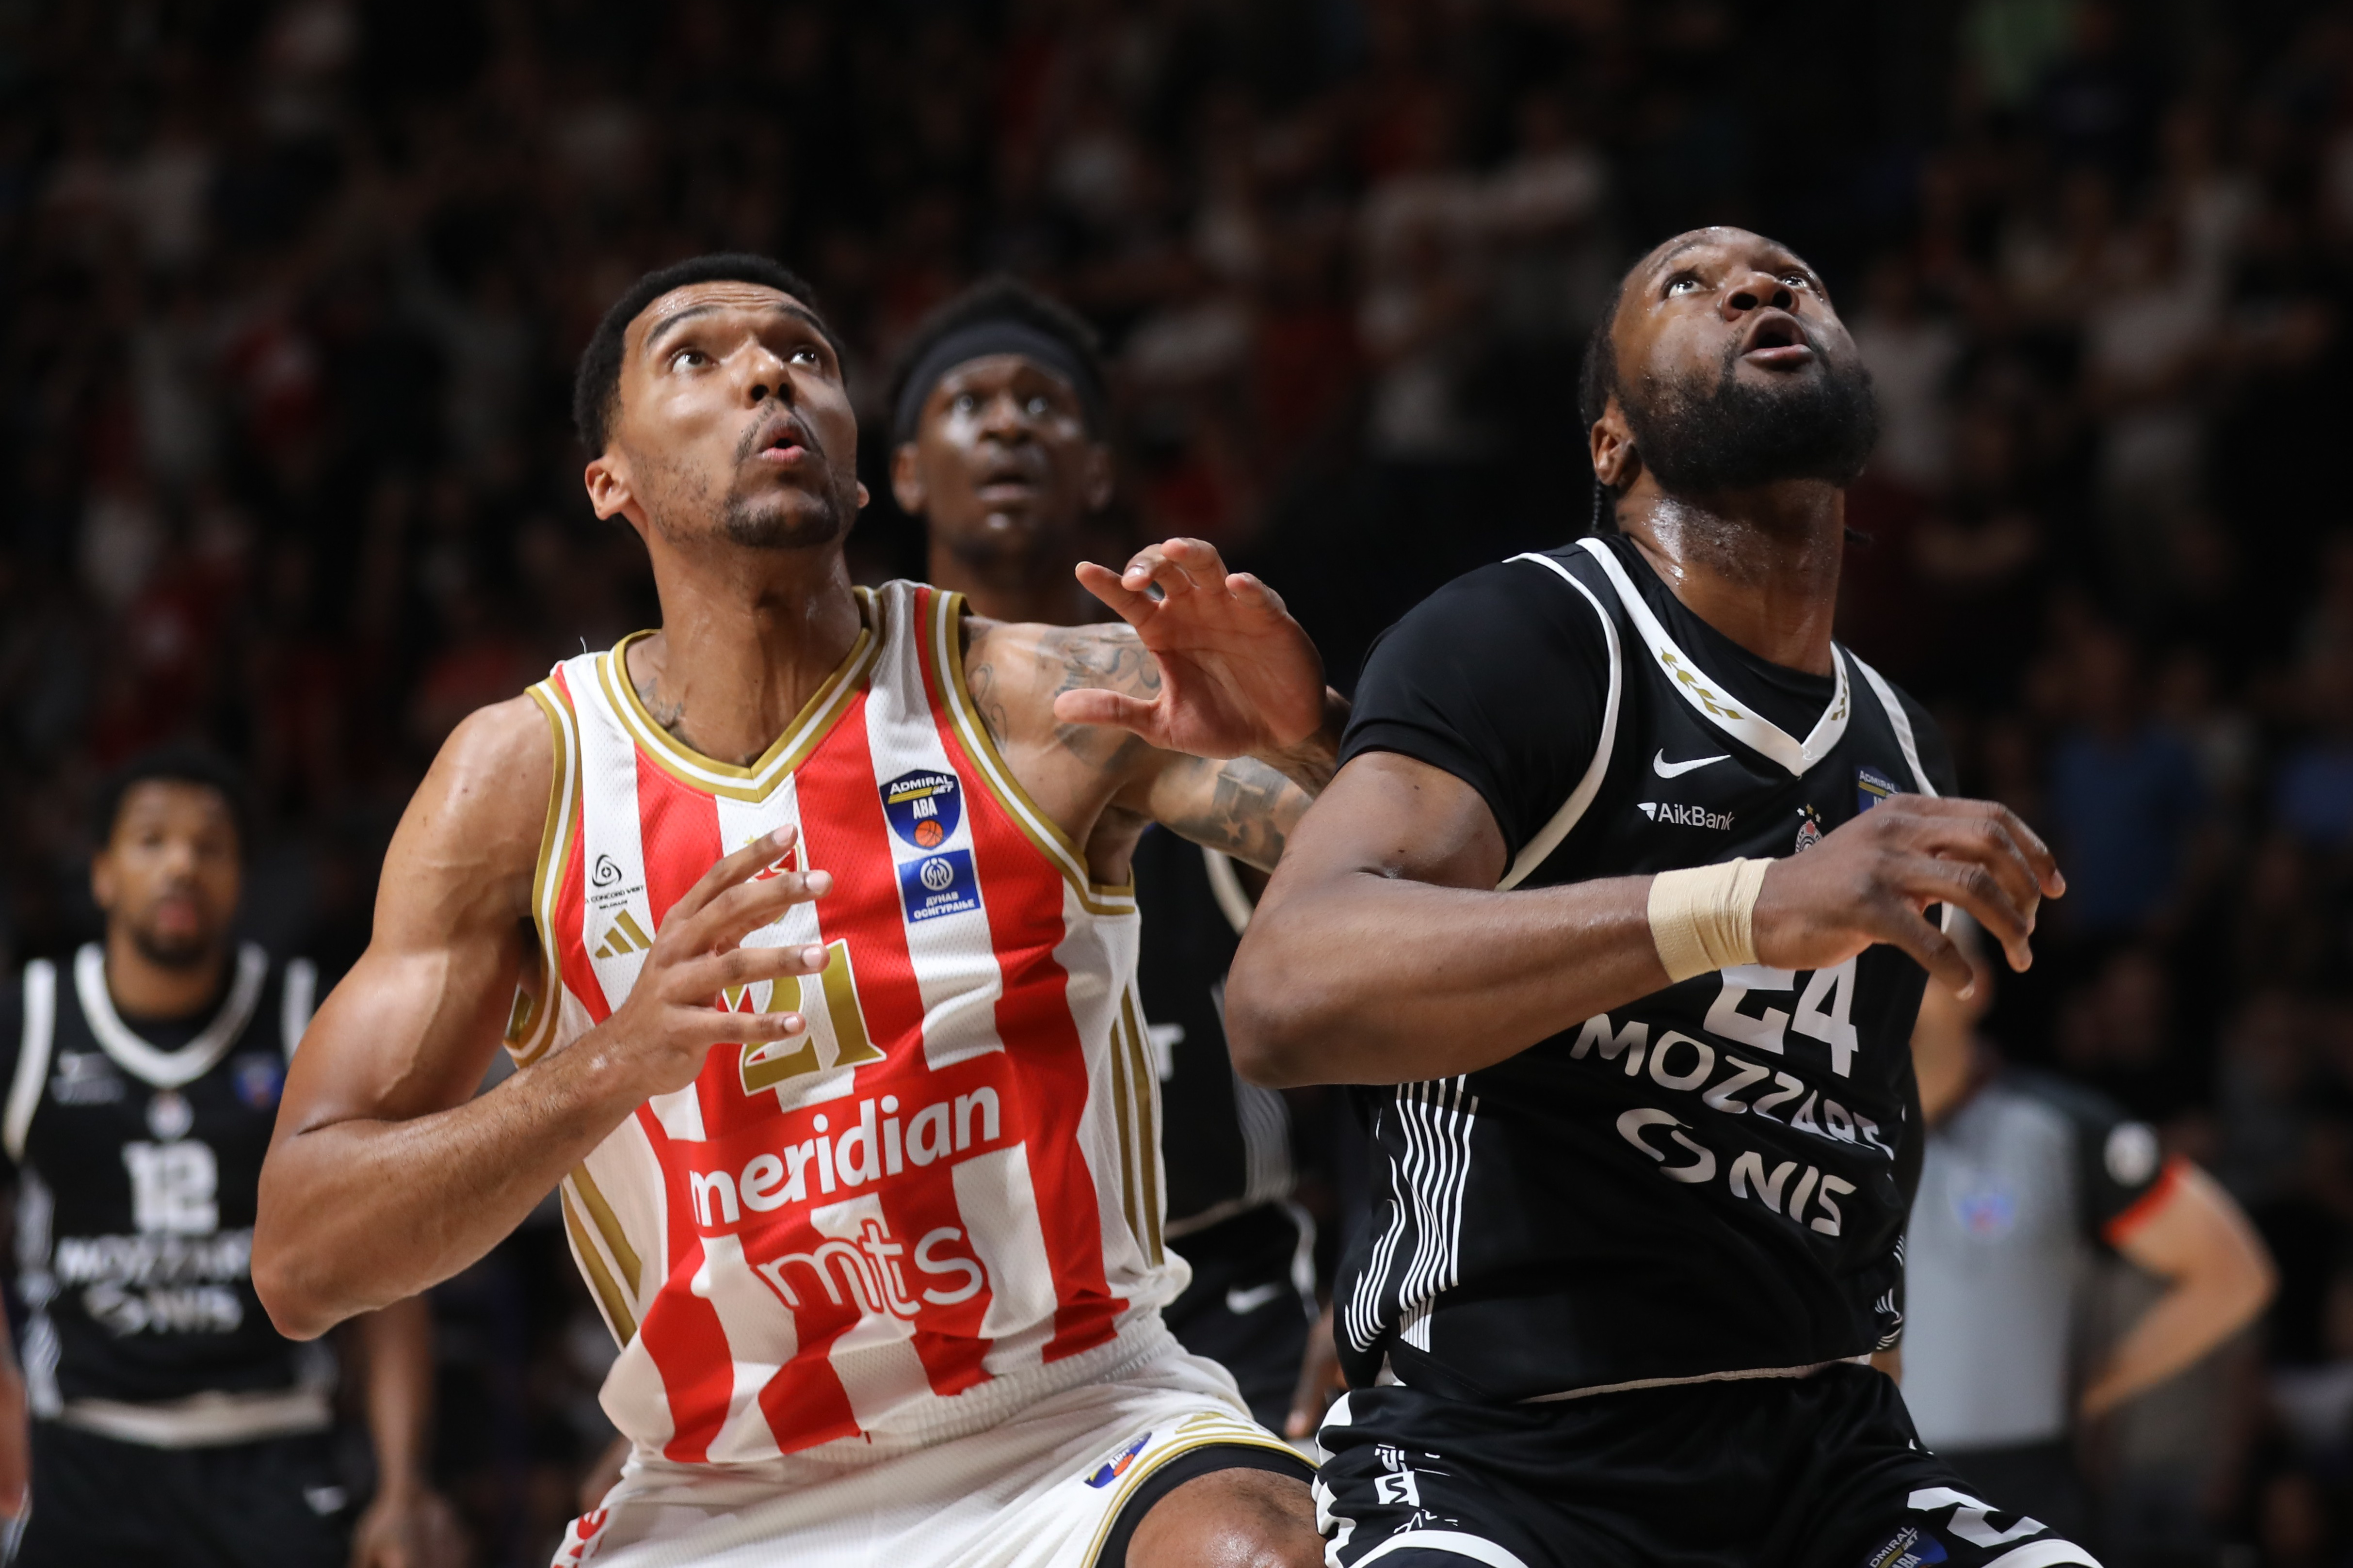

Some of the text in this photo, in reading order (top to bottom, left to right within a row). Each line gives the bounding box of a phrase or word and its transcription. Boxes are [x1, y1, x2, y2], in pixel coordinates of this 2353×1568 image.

[889, 775, 952, 795] ADMIRAL
[1859, 770, 1898, 794] ADMIRAL
[912, 796, 938, 820] ABA
[1658, 803, 1735, 831] AikBank
[913, 898, 975, 920] ОСИГУРАЊЕ
[925, 891, 959, 908] ДУНАВ
[689, 1086, 1001, 1228] meridian
[1729, 1151, 1857, 1236] NIS
[752, 1217, 983, 1317] mts
[1867, 1527, 1915, 1568] DMIRAL
